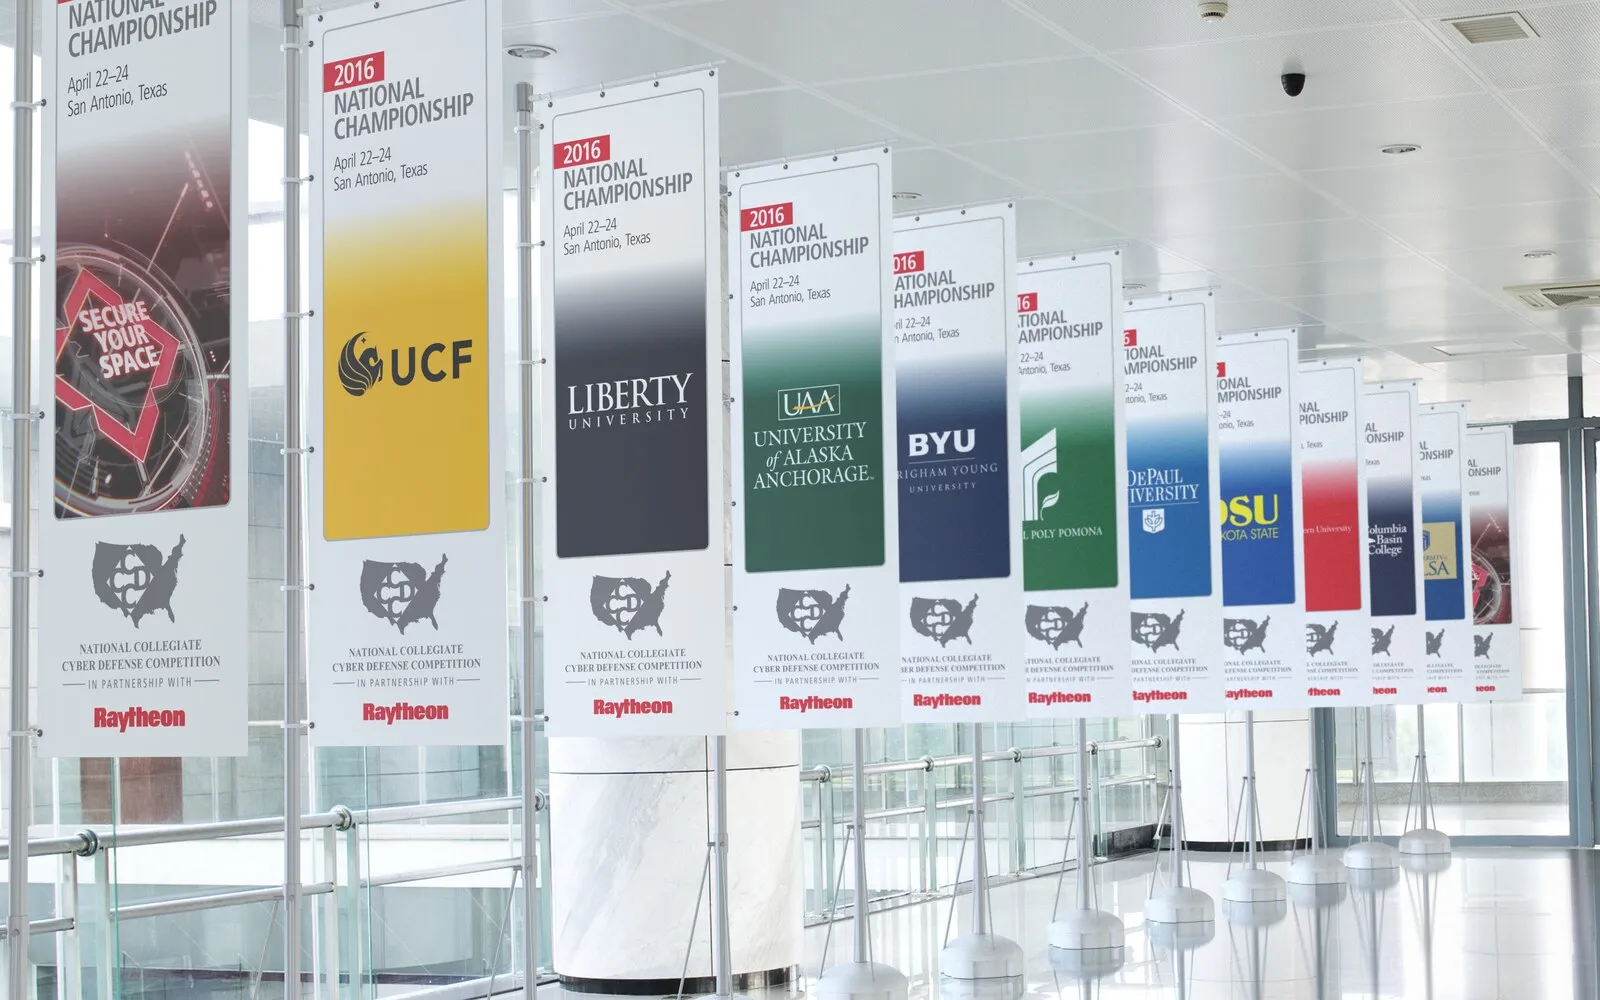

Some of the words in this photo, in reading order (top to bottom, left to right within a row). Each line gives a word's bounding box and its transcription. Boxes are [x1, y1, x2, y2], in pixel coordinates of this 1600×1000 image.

[69, 0, 217, 57] CHAMPIONSHIP
[334, 58, 374, 86] 2016
[68, 72, 91, 96] April
[68, 100, 86, 116] San
[90, 89, 134, 112] Antonio,
[138, 83, 168, 100] Texas
[334, 77, 424, 115] NATIONAL
[334, 93, 474, 140] CHAMPIONSHIP
[564, 140, 600, 164] 2016
[334, 153, 356, 173] April
[334, 177, 351, 191] San
[355, 168, 396, 187] Antonio,
[400, 164, 428, 179] Texas
[564, 158, 647, 189] NATIONAL
[564, 172, 692, 210] CHAMPIONSHIP
[750, 207, 784, 228] 2016
[564, 222, 584, 239] April
[751, 223, 827, 249] NATIONAL
[564, 243, 580, 255] San
[584, 236, 622, 252] Antonio,
[625, 233, 650, 246] Texas
[750, 236, 869, 268] CHAMPIONSHIP
[894, 254, 916, 271] 016
[750, 278, 769, 294] April
[895, 270, 956, 291] ATIONAL
[751, 296, 765, 308] San
[769, 291, 804, 305] Antonio,
[807, 288, 830, 300] Texas
[894, 282, 995, 308] HAMPIONSHIP
[78, 301, 149, 332] SECURE
[1018, 310, 1067, 328] TIONAL
[94, 325, 149, 353] YOUR
[902, 331, 934, 343] Antonio,
[938, 328, 959, 339] Texas
[1019, 322, 1103, 344] AMPIONSHIP
[1124, 345, 1164, 360] IONAL
[99, 346, 160, 378] SPACE
[392, 339, 472, 386] UCF
[1050, 363, 1071, 372] Texas
[568, 372, 693, 414] LIBERTY
[1149, 393, 1167, 401] Texas
[1218, 387, 1281, 403] MPIONSHIP
[784, 390, 834, 416] UAA
[569, 408, 688, 430] UNIVERSITY
[1300, 411, 1348, 424] PIONSHIP
[754, 422, 867, 447] UNIVERSITY
[908, 429, 976, 456] BYU
[1367, 432, 1404, 443] ONSHIP
[766, 450, 782, 471] of
[784, 445, 854, 466] ALASKA
[897, 468, 947, 479] RIGHAM
[952, 463, 998, 475] YOUNG
[910, 482, 976, 493] UNIVERSITY
[1128, 484, 1200, 503] IVERSITY
[1032, 529, 1055, 539] POLY
[1059, 526, 1102, 537] POMONA
[1221, 529, 1248, 541] KOTA
[1251, 528, 1279, 540] STATE
[1368, 524, 1407, 534] olumbia
[1376, 535, 1402, 544] Basin
[1368, 545, 1402, 557] College
[80, 642, 131, 654] NATIONAL
[134, 640, 202, 652] COLLEGIATE
[349, 647, 398, 657] NATIONAL
[400, 644, 463, 656] COLLEGIATE
[580, 651, 625, 660] NATIONAL
[628, 649, 686, 658] COLLEGIATE
[62, 660, 96, 671] CYBER
[98, 659, 143, 670] DEFENSE
[146, 656, 220, 668] COMPETITION
[811, 652, 864, 660] COLLEGIATE
[942, 654, 992, 662] COLLEGIATE
[1055, 656, 1100, 664] COLLEGIATE
[332, 663, 364, 672] CYBER
[367, 661, 408, 671] DEFENSE
[411, 658, 481, 670] COMPETITION
[565, 664, 594, 672] CYBER
[597, 663, 635, 671] DEFENSE
[638, 661, 702, 670] COMPETITION
[820, 662, 879, 671] COMPETITION
[951, 664, 1006, 672] COMPETITION
[88, 680, 97, 689] IN
[102, 678, 163, 688] PARTNERSHIP
[168, 677, 192, 687] WITH
[370, 678, 428, 687] PARTNERSHIP
[432, 677, 454, 685] WITH
[588, 678, 596, 686] IN
[600, 677, 653, 685] PARTNERSHIP
[657, 676, 678, 684] WITH
[914, 694, 981, 709] Raytheon
[1029, 692, 1091, 705] Raytheon
[1225, 689, 1272, 700] aytheon
[594, 699, 672, 718] Raytheon
[780, 696, 852, 712] Raytheon
[94, 707, 185, 732] Raytheon
[363, 702, 448, 724] Raytheon
